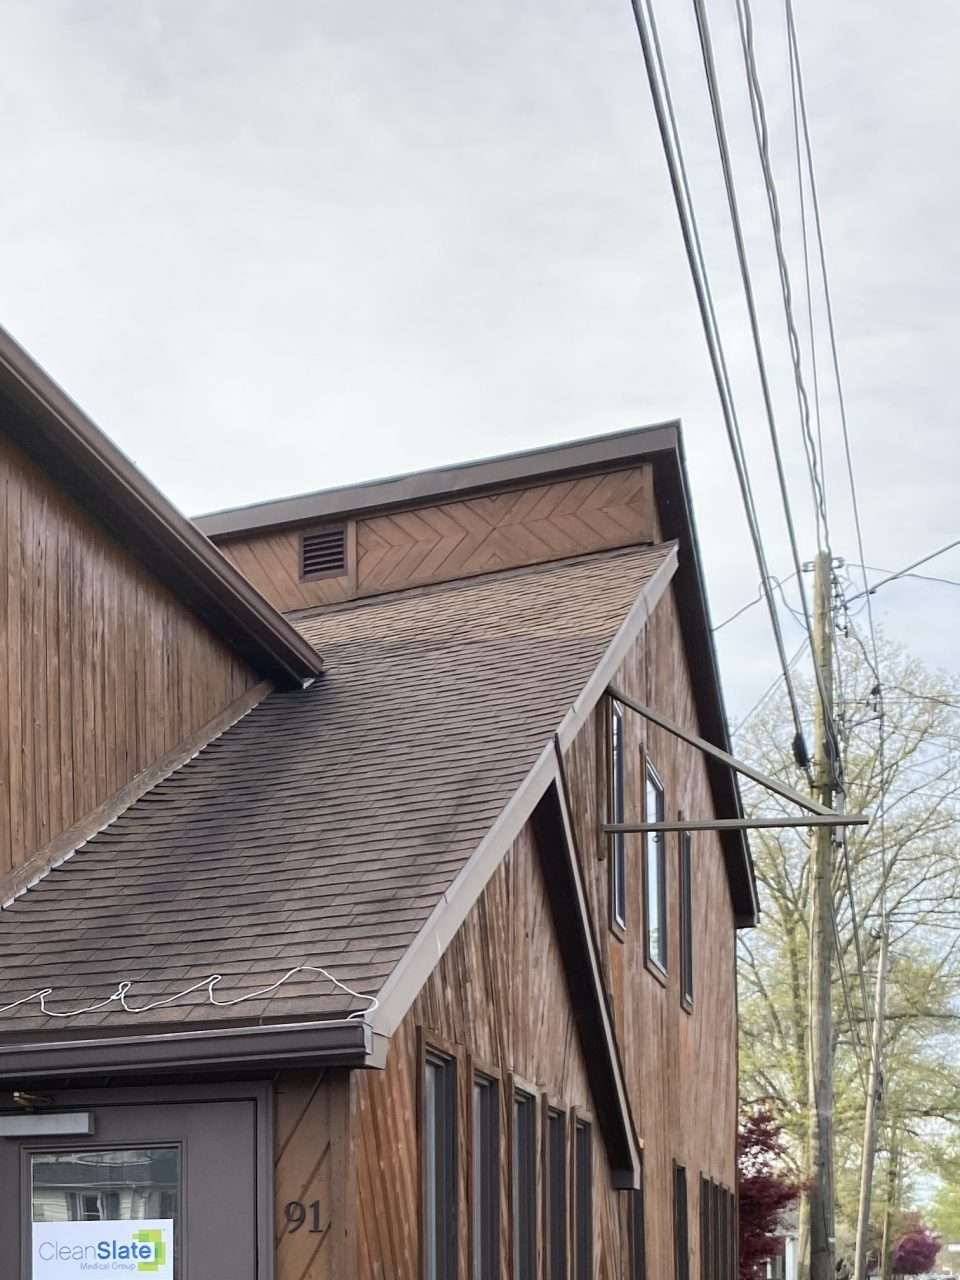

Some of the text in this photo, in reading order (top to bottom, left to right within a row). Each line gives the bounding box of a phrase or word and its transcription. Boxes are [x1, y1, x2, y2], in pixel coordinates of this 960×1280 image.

[284, 1200, 323, 1233] 91
[39, 1240, 151, 1261] CleanSlate
[80, 1262, 136, 1272] Medical Group
